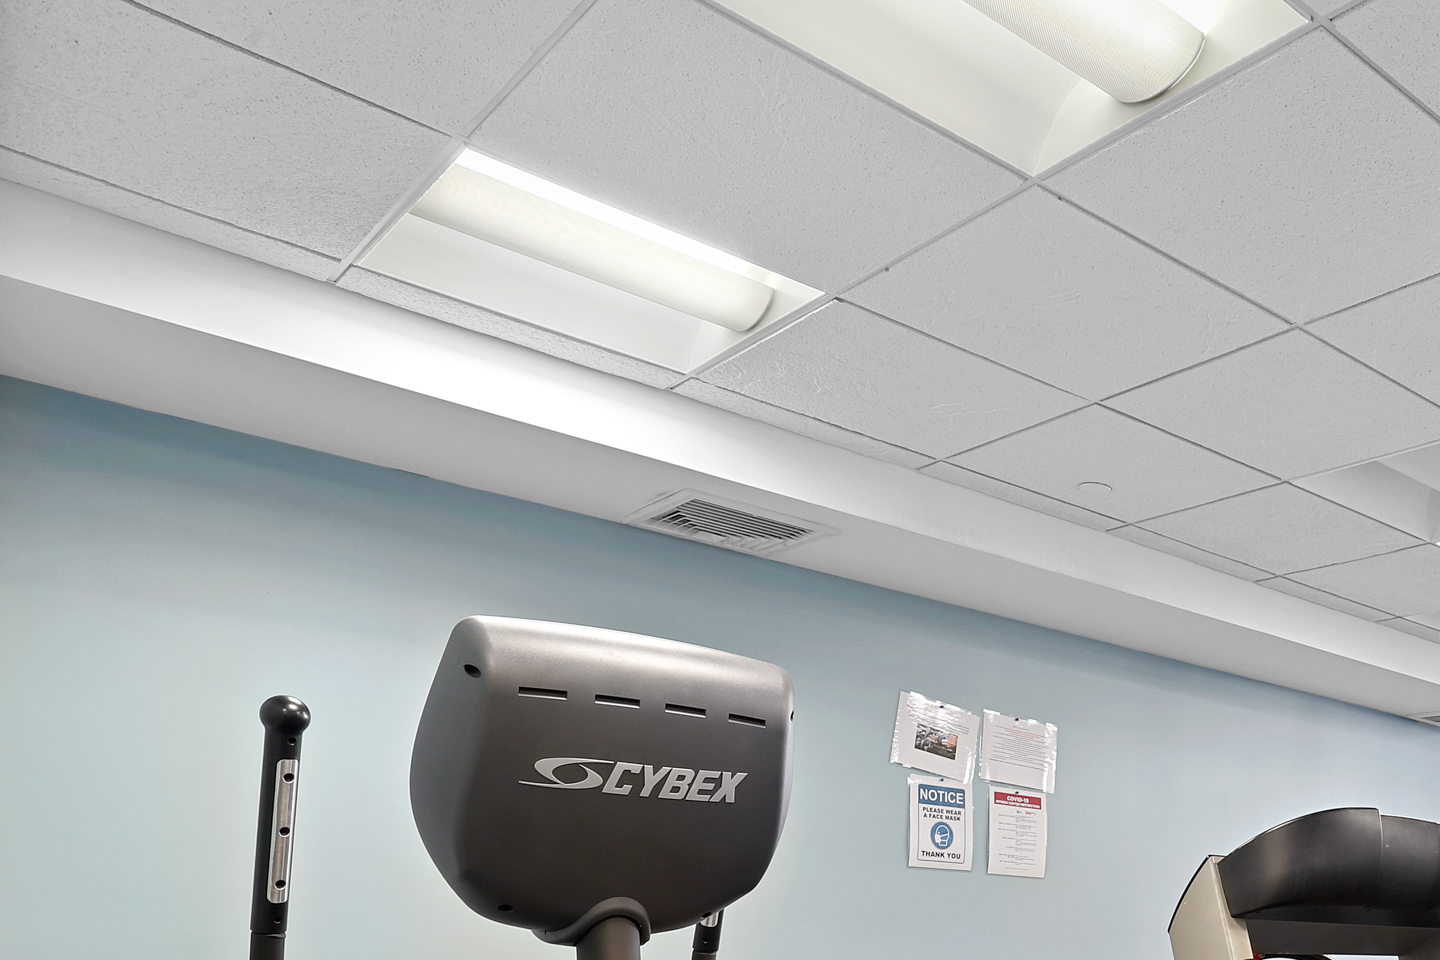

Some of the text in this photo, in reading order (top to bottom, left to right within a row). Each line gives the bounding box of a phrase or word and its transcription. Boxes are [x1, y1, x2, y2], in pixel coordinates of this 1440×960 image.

[602, 761, 749, 804] CYBEX
[919, 788, 964, 804] NOTICE
[1006, 795, 1030, 804] COVID-19
[922, 806, 944, 814] PLEASE
[921, 850, 961, 860] THANK YOU
